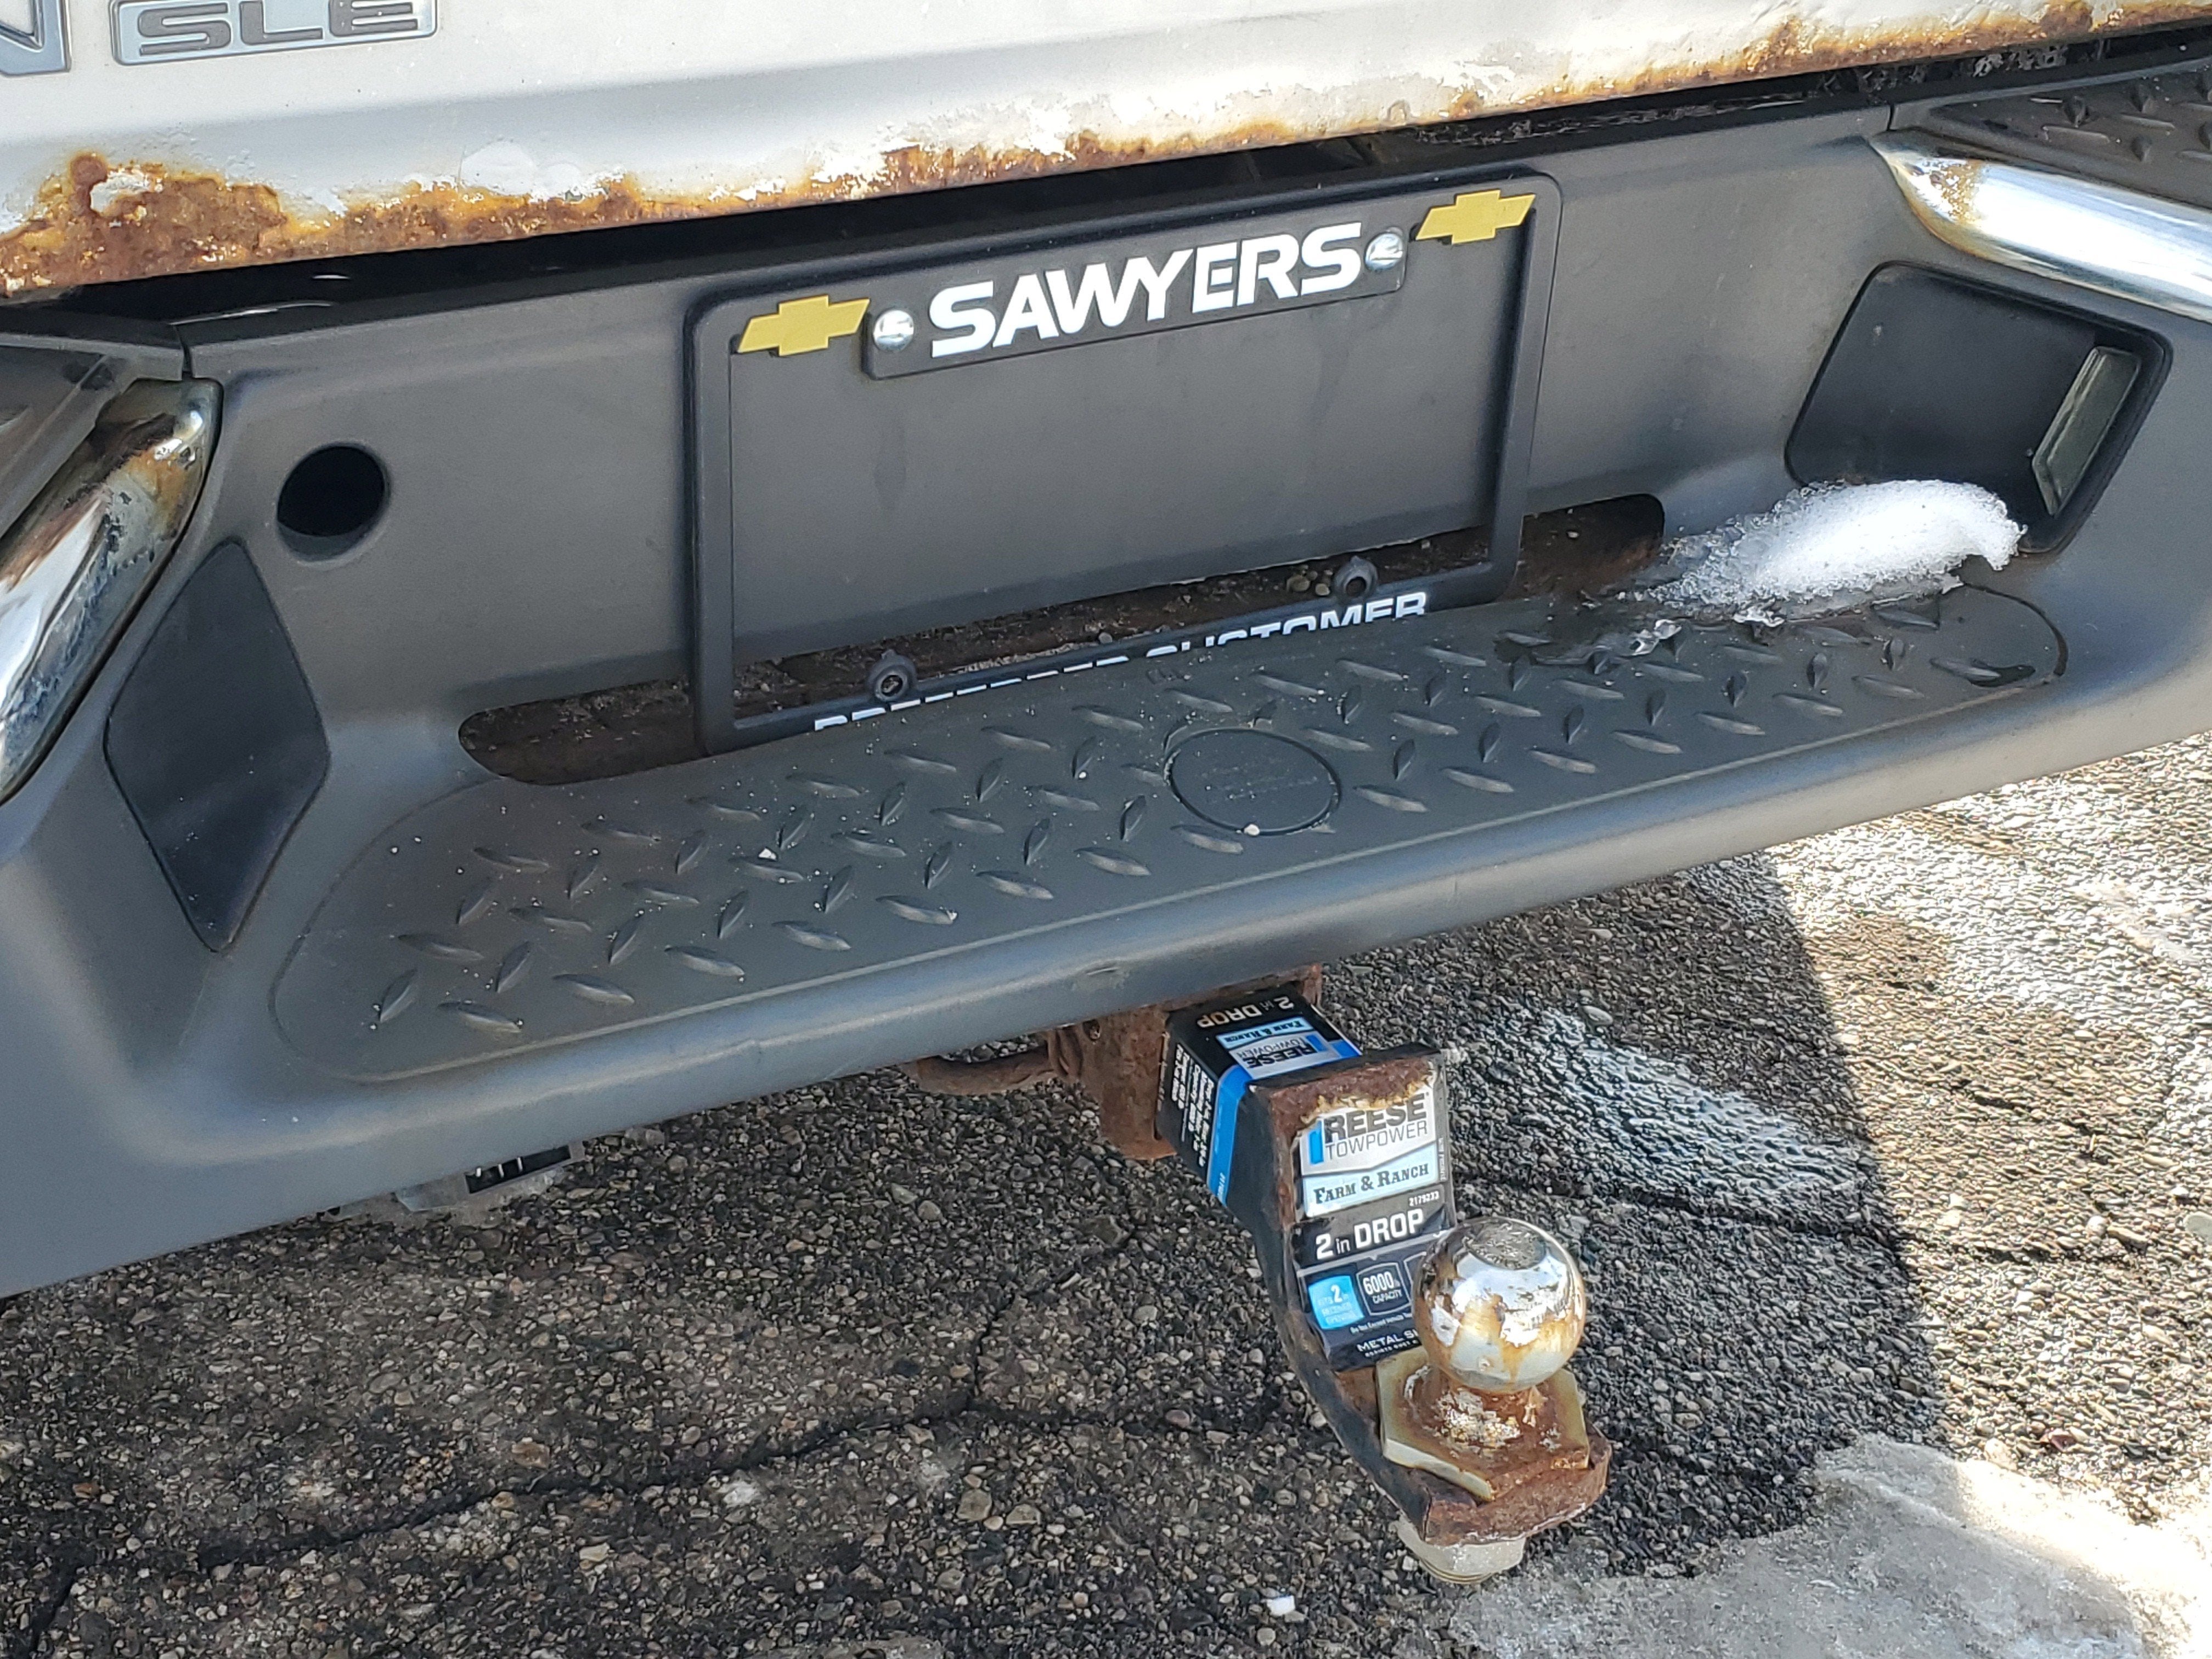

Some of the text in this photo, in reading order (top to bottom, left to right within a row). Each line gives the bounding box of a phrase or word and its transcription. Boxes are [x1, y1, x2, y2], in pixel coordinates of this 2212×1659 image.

[138, 0, 419, 57] SLE
[929, 222, 1362, 358] SAWYERS
[1197, 1004, 1262, 1028] DROP
[1274, 996, 1294, 1010] 2
[1242, 1043, 1318, 1069] REESE
[1323, 1092, 1427, 1144] REESE
[1325, 1120, 1427, 1160] TOWPOWER
[1313, 1163, 1429, 1204] FARM & RANCH
[1316, 1208, 1424, 1260] 2 in DROP
[1330, 1284, 1343, 1303] 2
[1362, 1271, 1395, 1295] 6000
[1373, 1289, 1403, 1304] CAPACITY
[1356, 1334, 1404, 1352] METAL
